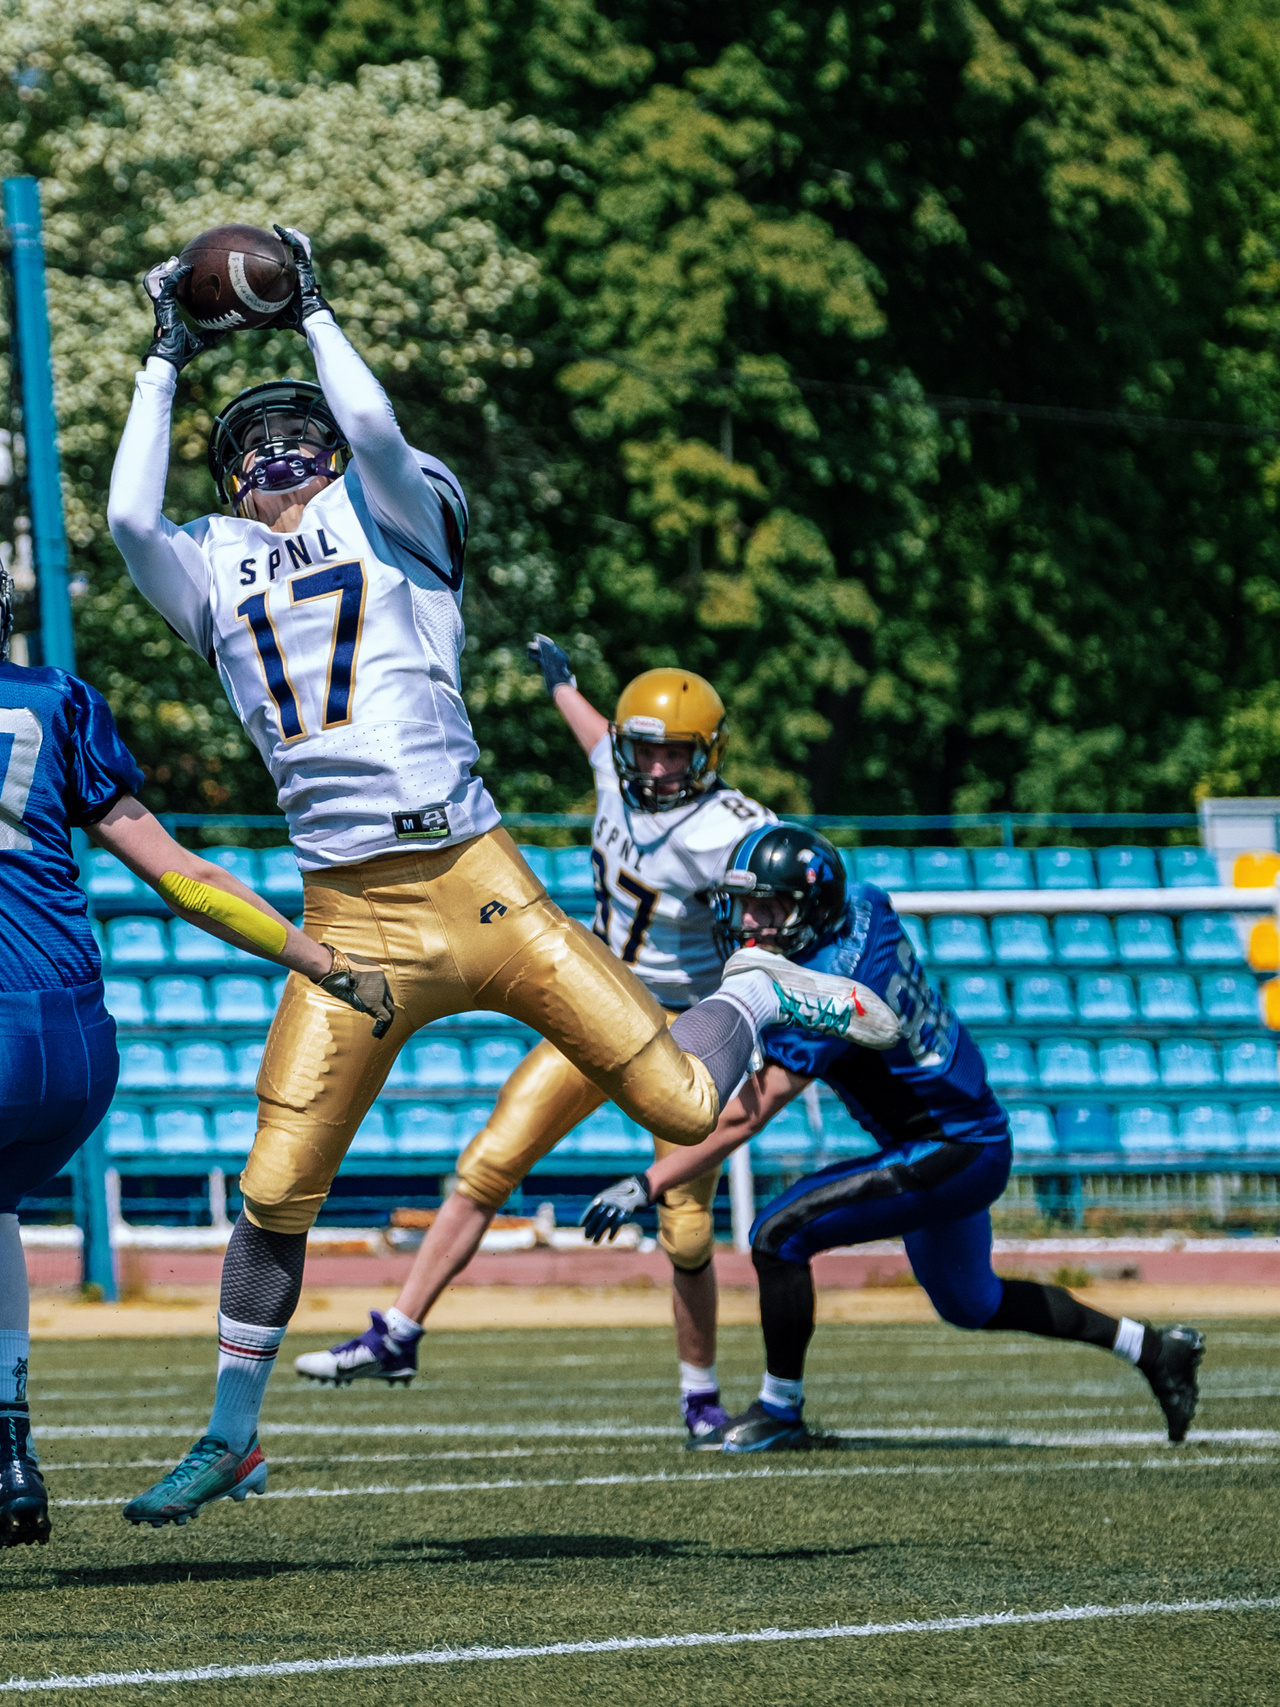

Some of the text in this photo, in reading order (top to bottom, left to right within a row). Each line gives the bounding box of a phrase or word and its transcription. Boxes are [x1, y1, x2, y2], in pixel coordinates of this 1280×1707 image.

[238, 529, 338, 586] SPNL
[234, 557, 368, 744] 17
[401, 818, 415, 831] M
[596, 815, 644, 873] SPNL
